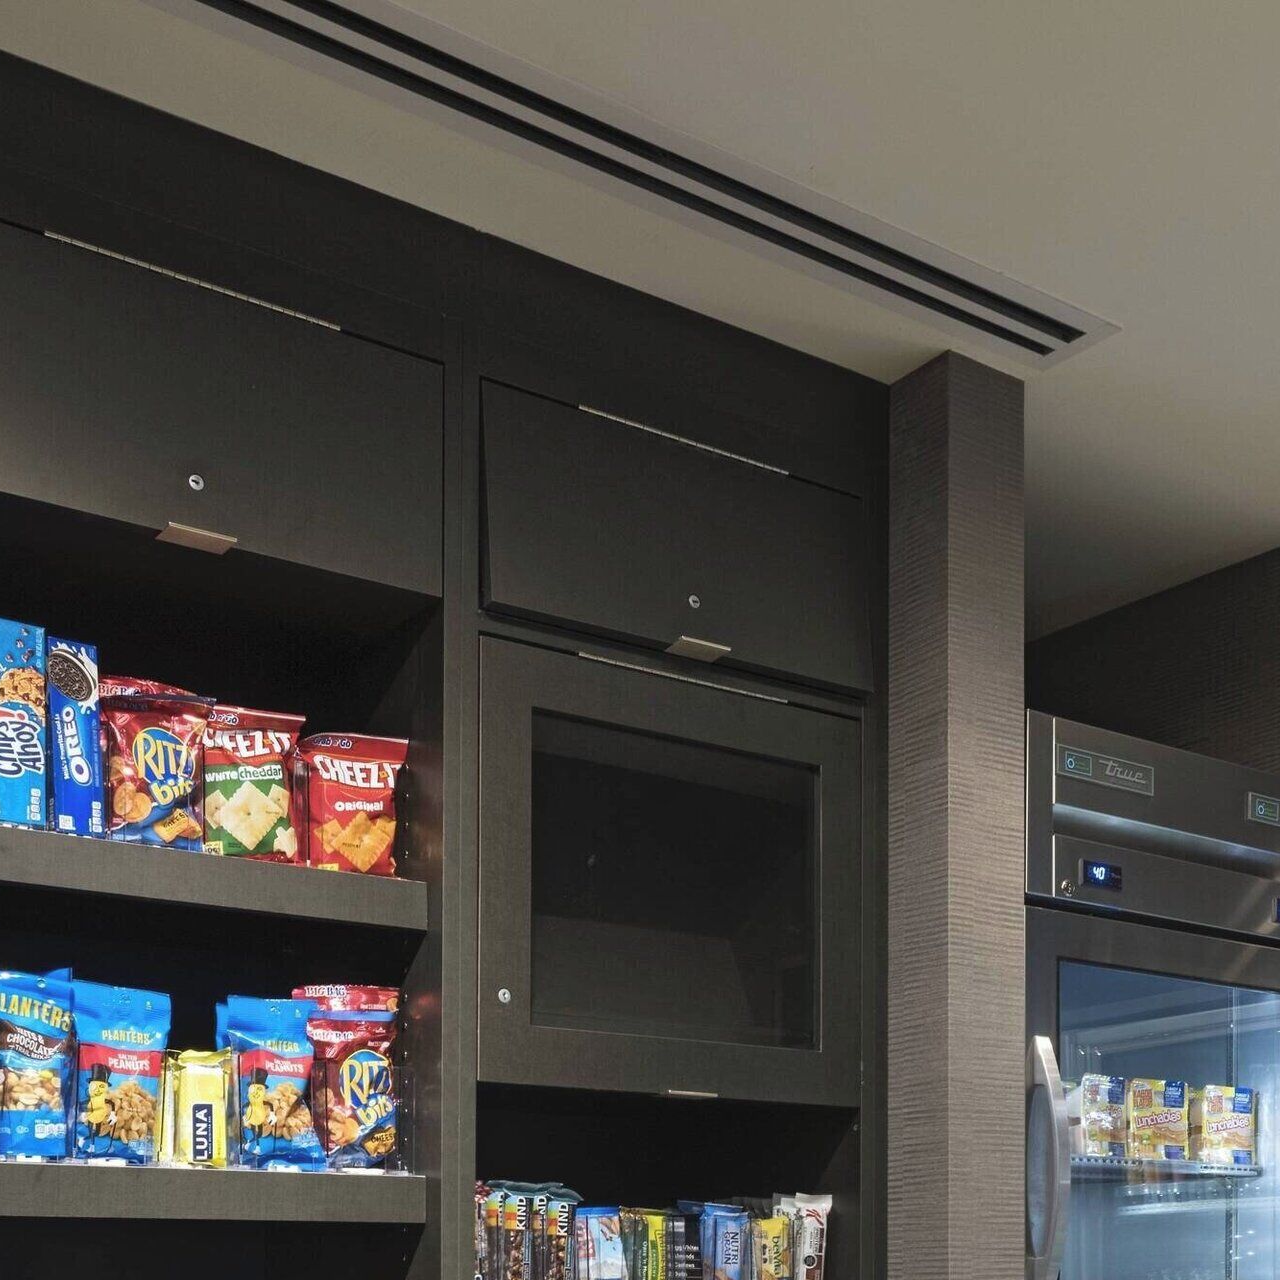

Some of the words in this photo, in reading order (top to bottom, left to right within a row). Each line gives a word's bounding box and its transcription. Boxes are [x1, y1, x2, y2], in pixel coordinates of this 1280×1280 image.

[62, 706, 93, 786] OREO
[136, 732, 193, 780] RITZ
[239, 765, 282, 780] cheddar
[1093, 866, 1106, 881] 40
[305, 985, 325, 996] BIG
[326, 986, 348, 998] BAG
[101, 1030, 152, 1045] PLANTERS
[108, 1057, 151, 1072] PEANUTS
[265, 1062, 305, 1073] PEANUTS
[1136, 1111, 1182, 1128] Lunchables
[1207, 1116, 1250, 1134] Lunchables
[195, 1108, 208, 1160] LUNA
[516, 1196, 526, 1230] KIND
[557, 1202, 569, 1235] KIND
[730, 1231, 739, 1265] NUTRI
